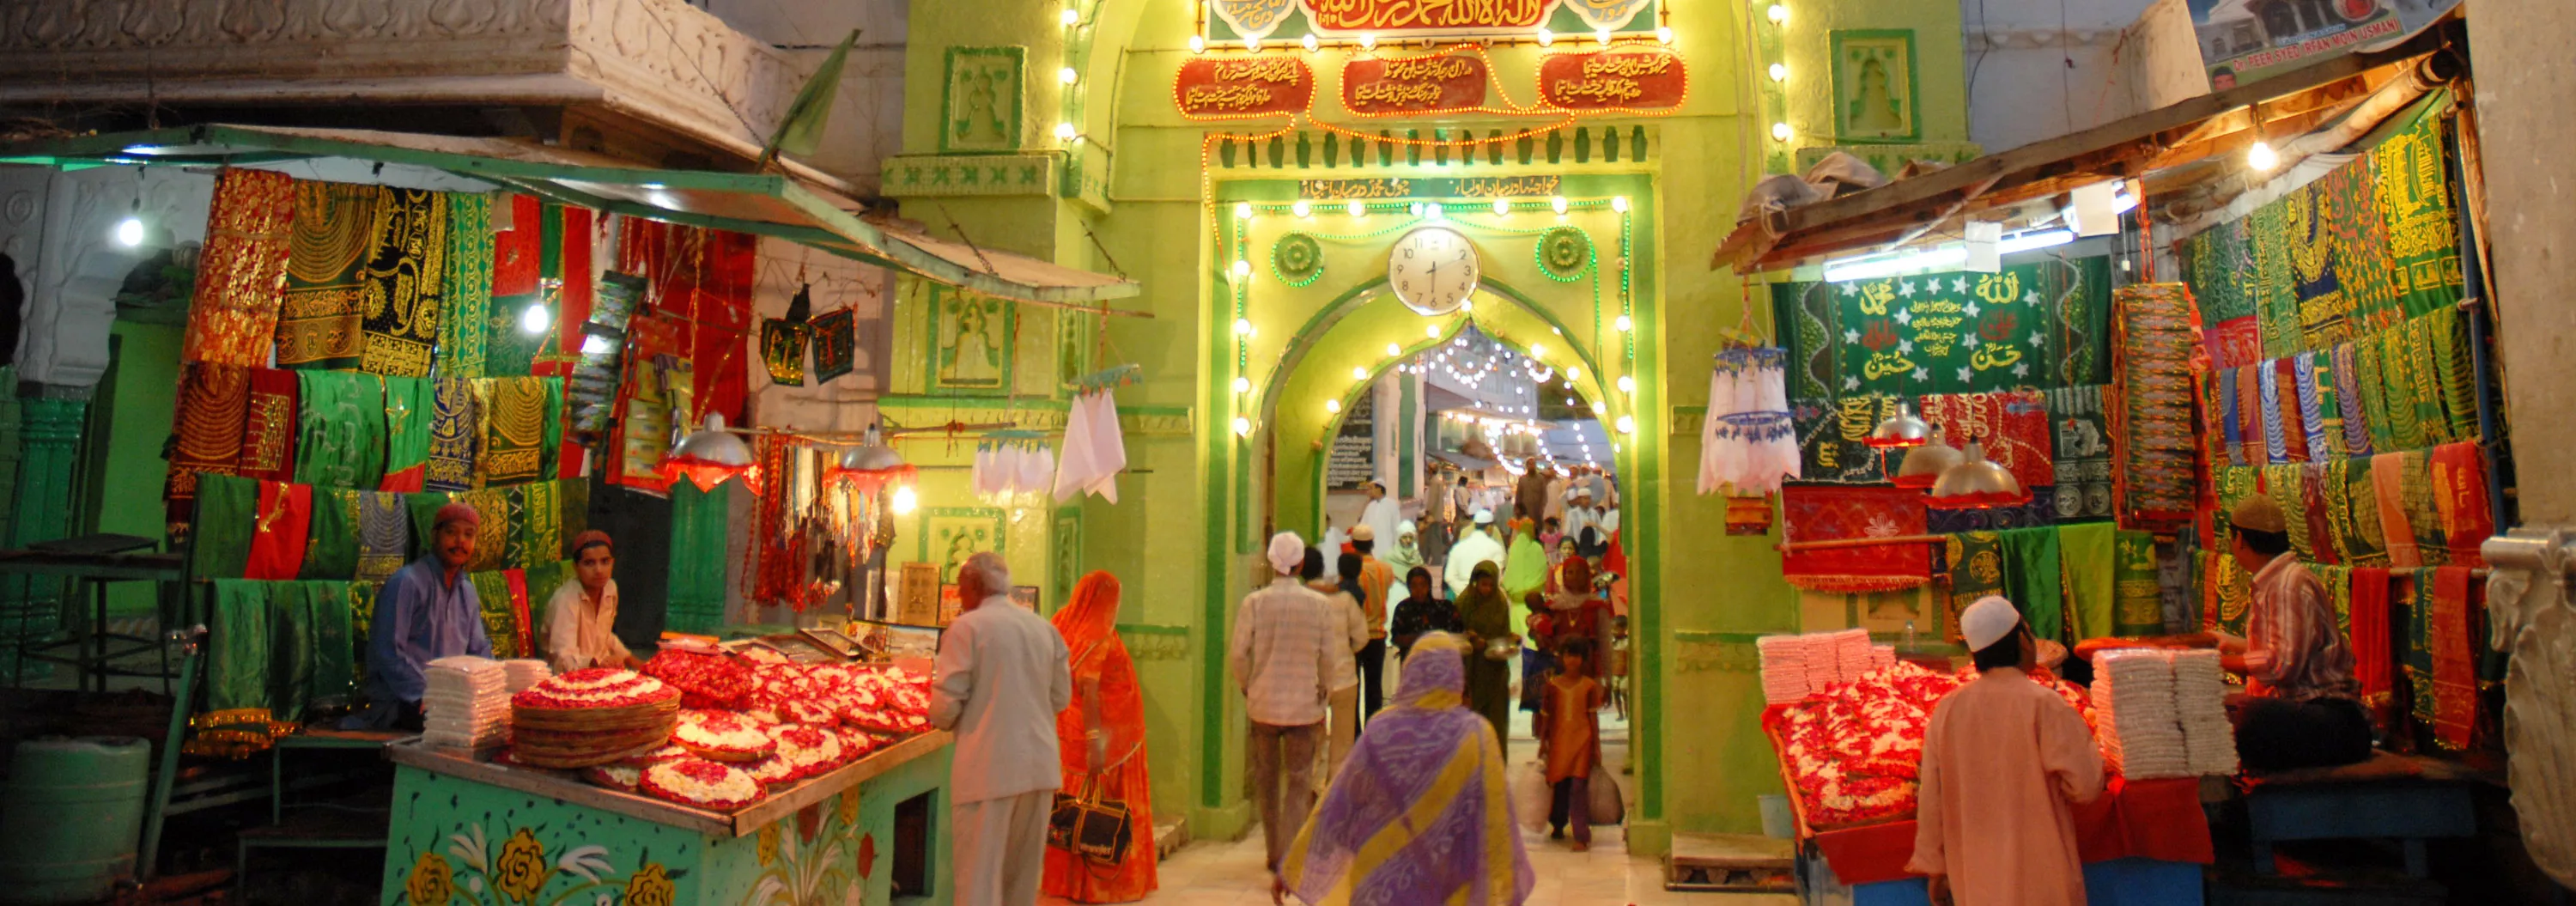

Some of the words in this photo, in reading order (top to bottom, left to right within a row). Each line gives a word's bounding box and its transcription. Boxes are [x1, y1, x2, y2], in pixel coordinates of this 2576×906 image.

[2247, 52, 2274, 70] PEER
[2275, 46, 2302, 62] SYED
[2304, 37, 2330, 55] IRFAN
[2332, 29, 2358, 47] MOIN
[2360, 17, 2400, 40] USMANI
[1403, 248, 1413, 259] 10
[1459, 249, 1467, 260] 2
[1397, 265, 1404, 275] 9
[1463, 265, 1471, 277] 3
[1401, 281, 1408, 291] 8
[1459, 282, 1466, 291] 4
[1416, 293, 1423, 303] 7
[1431, 297, 1437, 307] 6
[1447, 293, 1454, 304] 5
